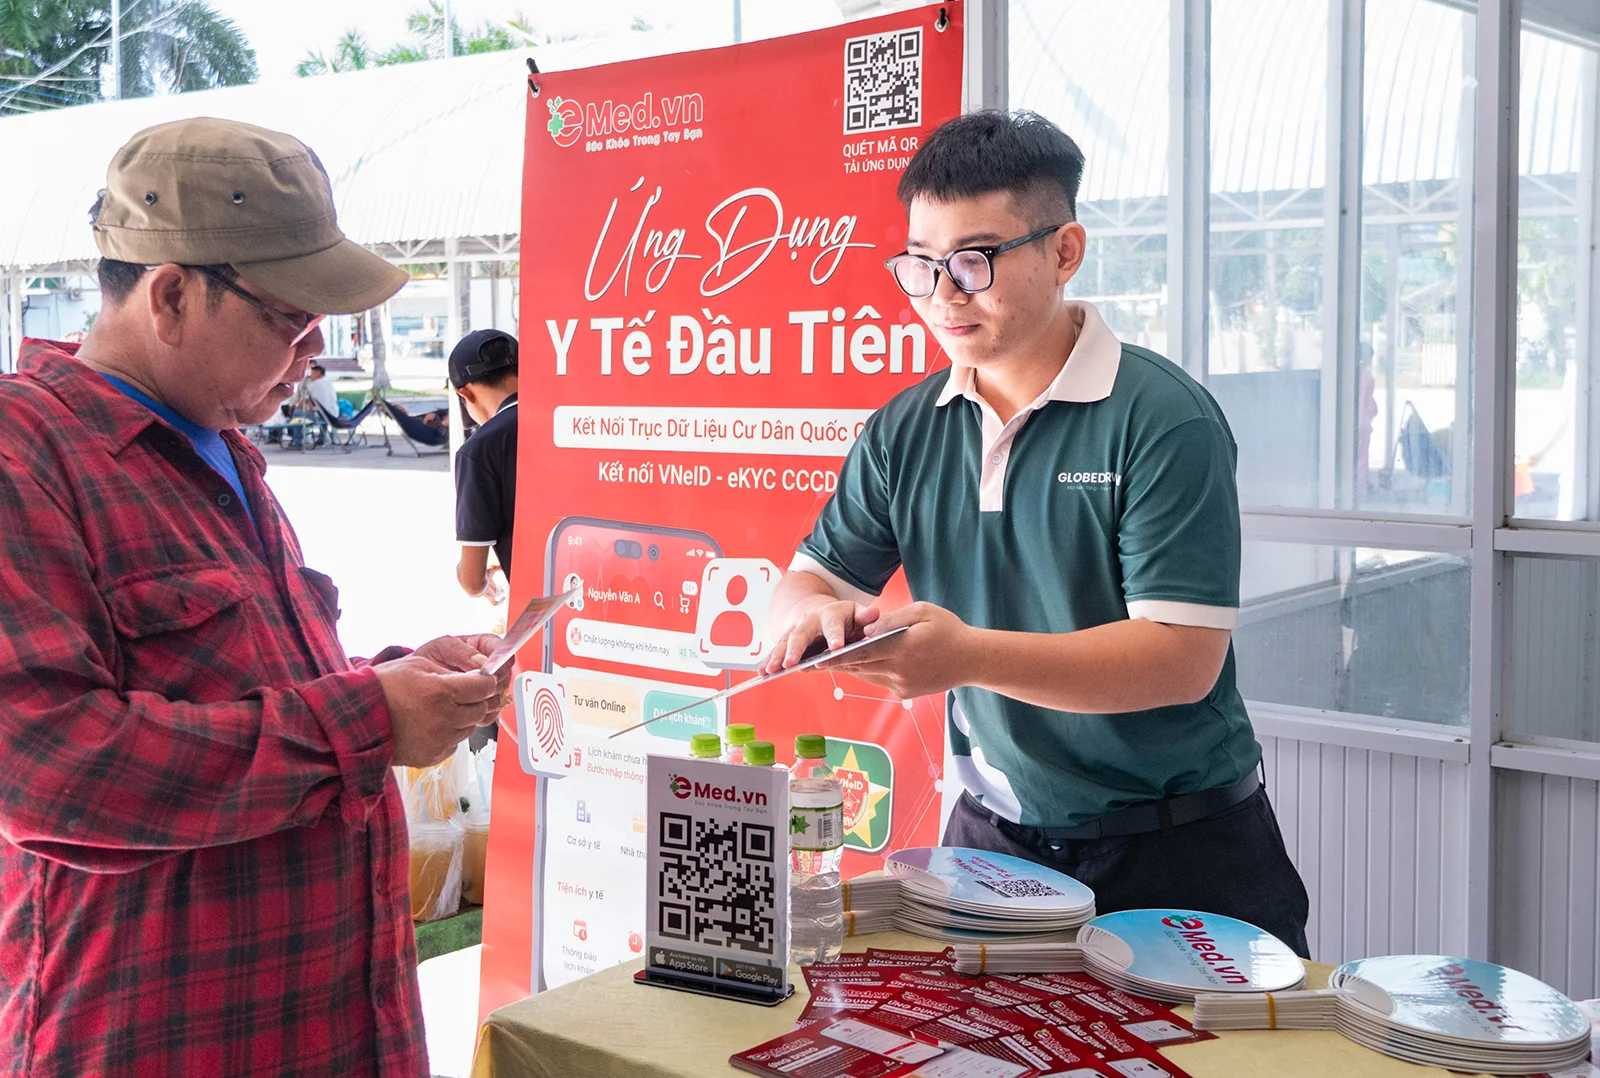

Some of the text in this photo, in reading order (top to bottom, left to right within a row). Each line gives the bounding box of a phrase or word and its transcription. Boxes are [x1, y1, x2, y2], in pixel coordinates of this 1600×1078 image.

[550, 92, 704, 147] eMed.vn
[632, 133, 661, 146] Trong
[663, 130, 681, 143] Tay
[842, 135, 919, 158] QUÉT MÃ QR
[843, 156, 912, 174] TẢI ỨNG DỤN
[584, 175, 877, 301] Ứng Dụng
[545, 305, 928, 376] Y Tế Đầu Tiên
[571, 417, 596, 436] Kết
[599, 417, 625, 437] Nối
[628, 417, 663, 442] Trục
[667, 417, 691, 438] Dữ
[693, 417, 728, 443] Liệu
[732, 418, 758, 440] Cư
[762, 418, 795, 441] Dân
[800, 418, 848, 445] Quốc
[598, 460, 625, 484] Kết
[628, 463, 654, 484] nối
[658, 464, 712, 487] VNeID
[727, 466, 777, 490] eKYC
[781, 468, 838, 494] CCCD
[567, 535, 583, 547] 9:41
[618, 590, 634, 604] Văn
[634, 593, 641, 605] A
[616, 639, 635, 652] không
[659, 646, 671, 657] nay
[582, 696, 599, 711] vấn
[600, 698, 627, 714] Online
[684, 713, 706, 726] khám
[603, 748, 622, 761] khám
[623, 753, 641, 765] chưa
[624, 771, 645, 785] thông
[671, 775, 768, 807] eMed.vn
[724, 803, 742, 812] Trong
[742, 806, 755, 814] Tay
[587, 841, 594, 850] y
[557, 880, 605, 900] Tiện ích y tế
[561, 945, 583, 960] Thông
[669, 952, 691, 961] Available
[668, 958, 709, 973] App Store
[735, 969, 779, 986] Google Play
